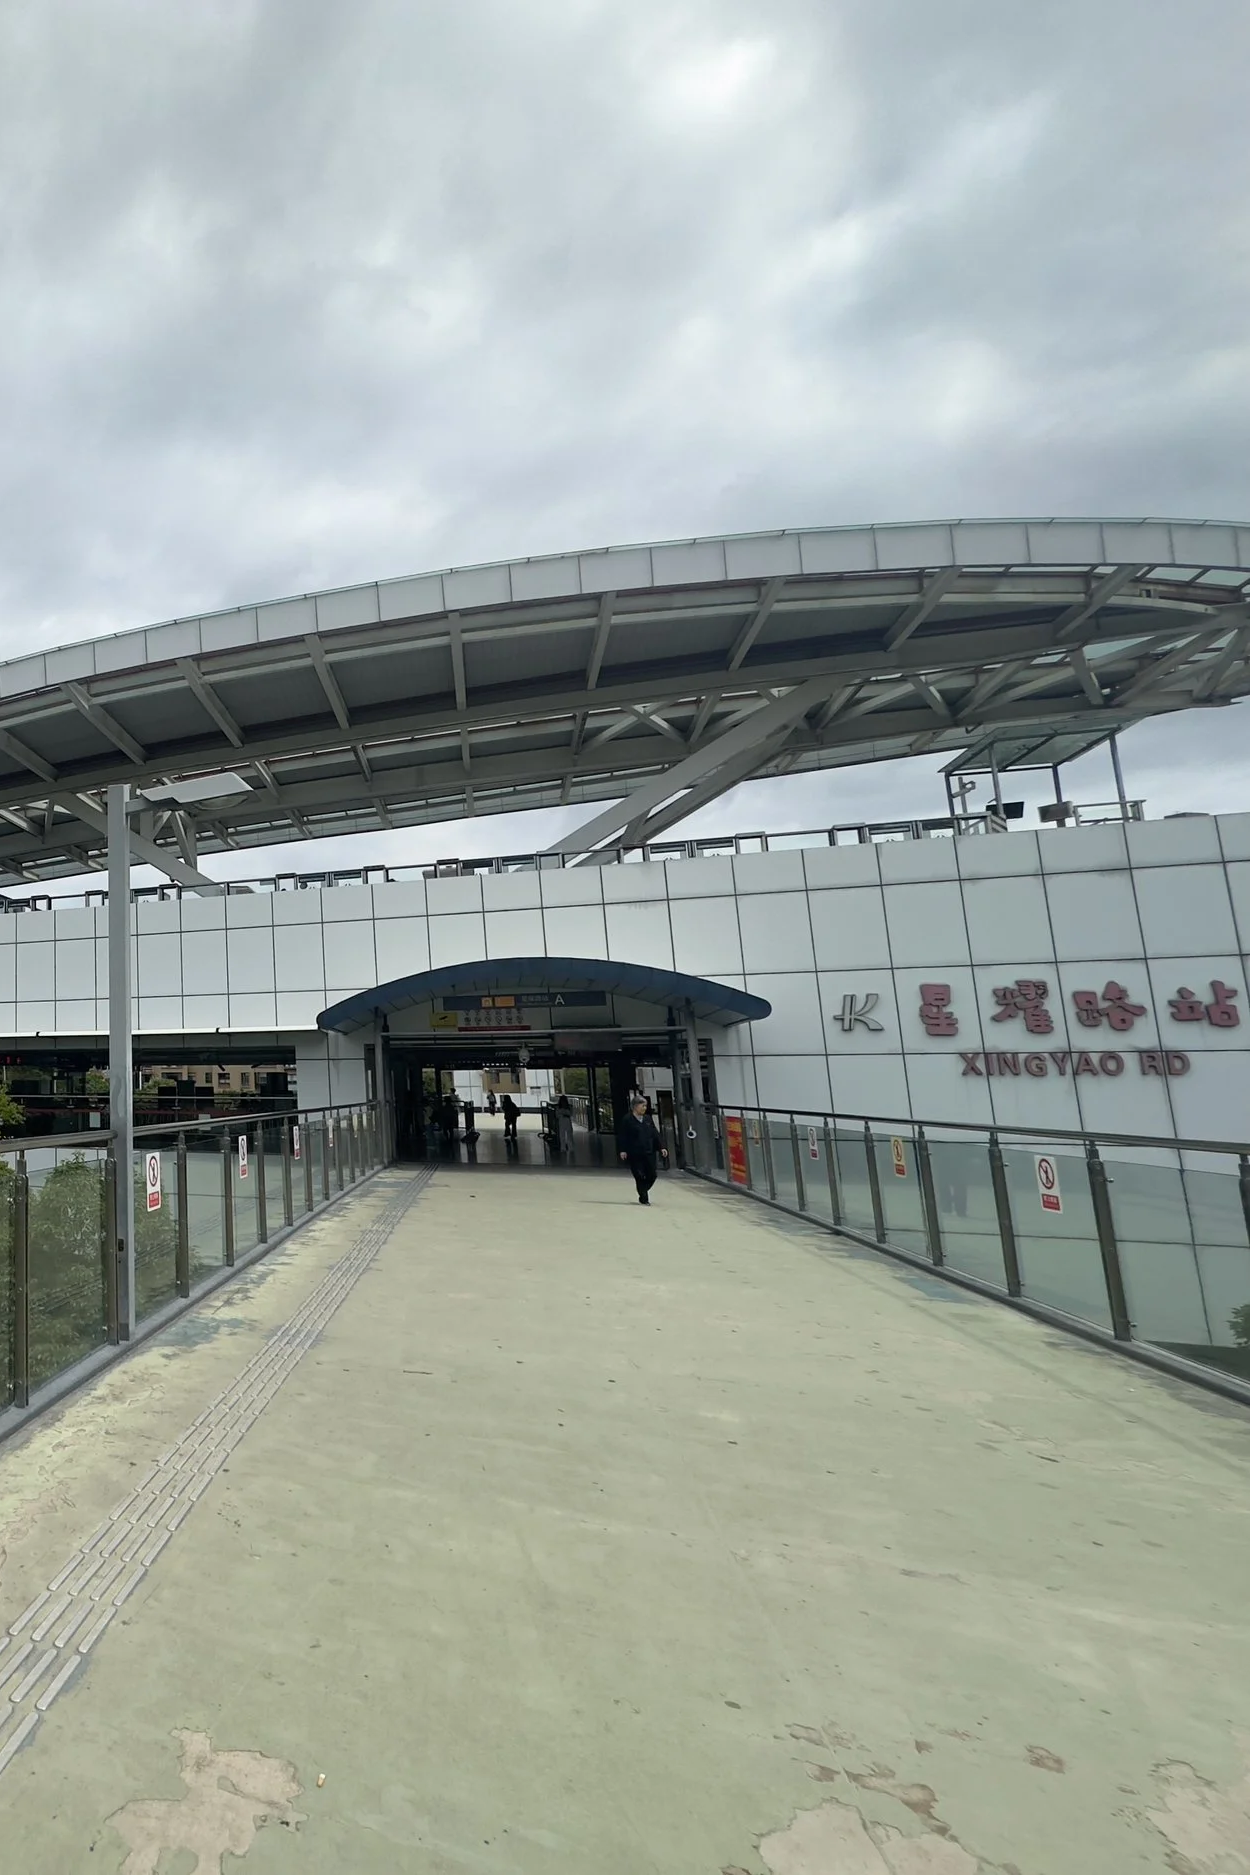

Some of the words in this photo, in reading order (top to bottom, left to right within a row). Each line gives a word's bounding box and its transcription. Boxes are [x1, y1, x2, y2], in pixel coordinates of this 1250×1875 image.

[554, 993, 565, 1005] A
[918, 979, 1241, 1037] 星耀路站
[961, 1051, 1125, 1077] XINGYAO
[1139, 1051, 1192, 1077] RD
